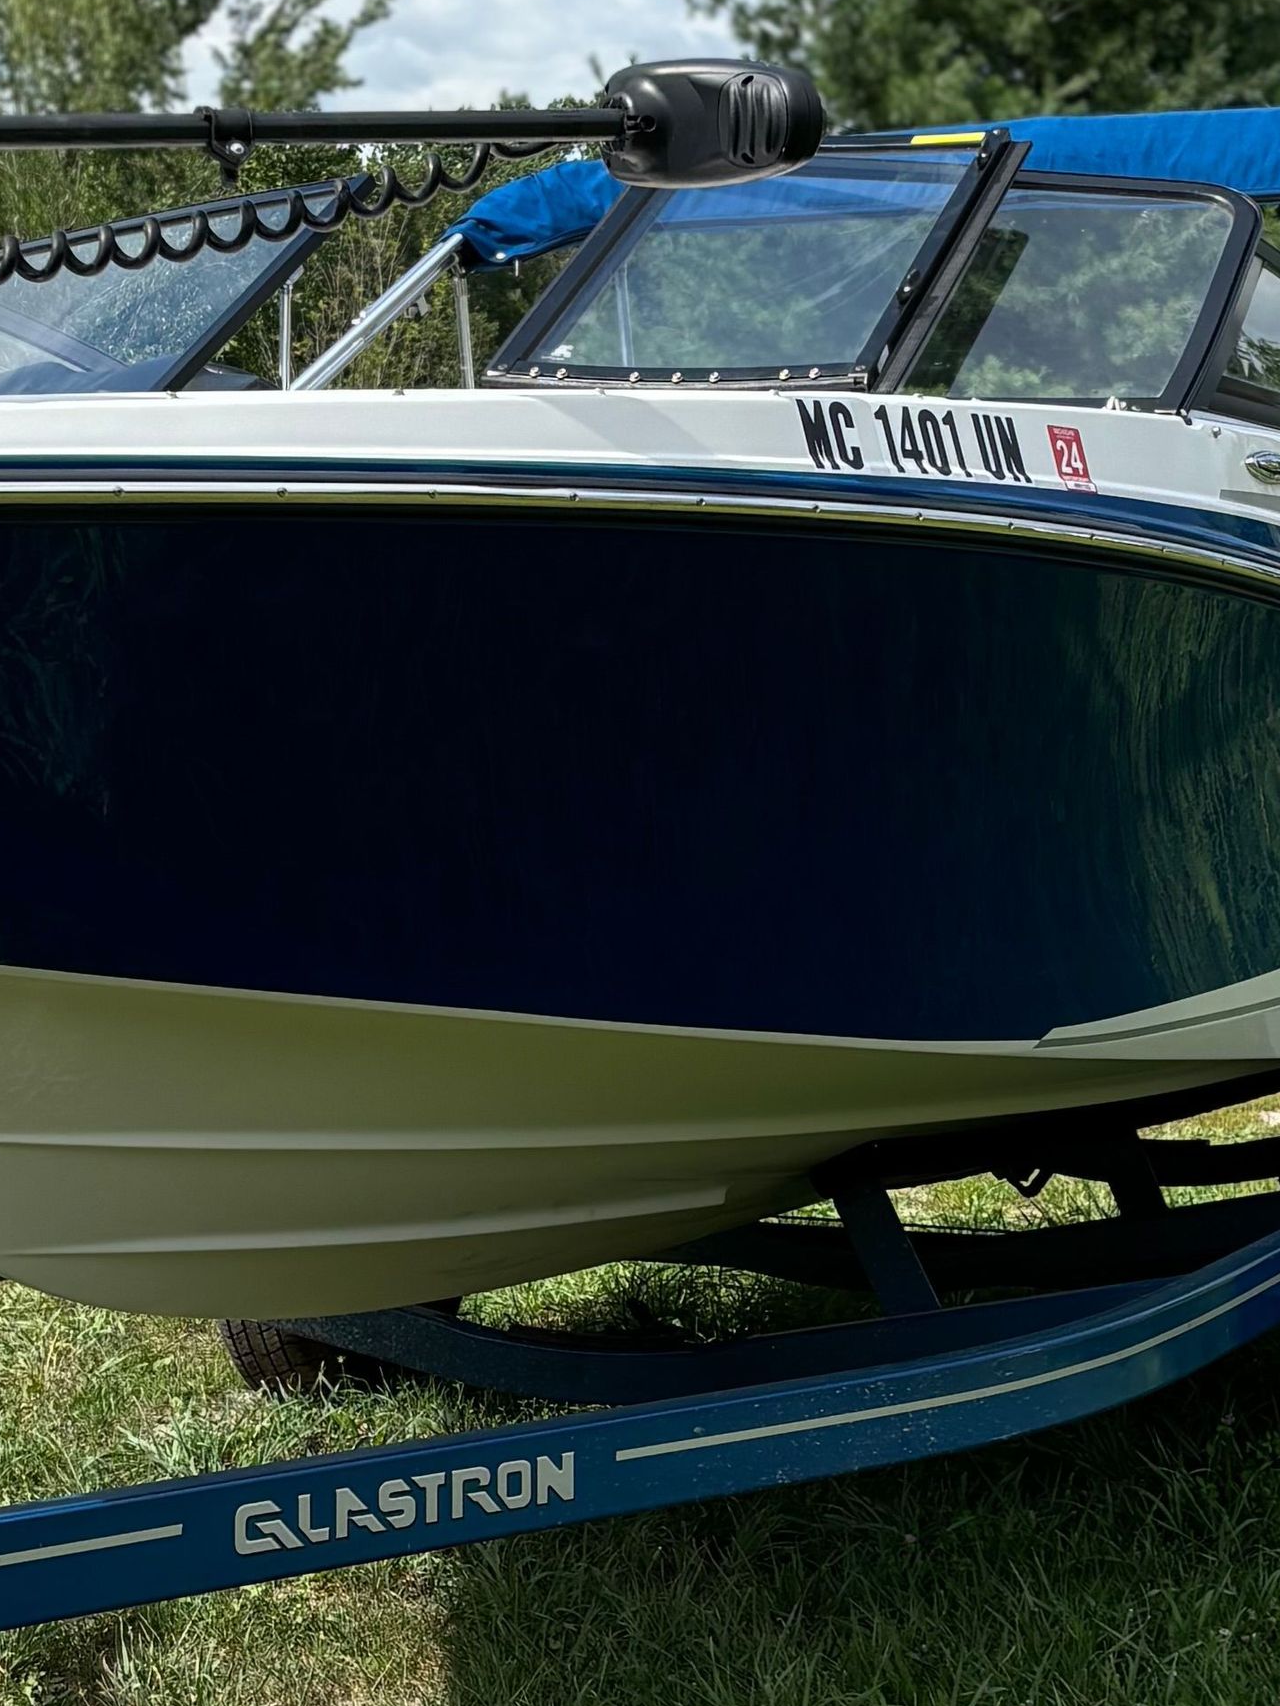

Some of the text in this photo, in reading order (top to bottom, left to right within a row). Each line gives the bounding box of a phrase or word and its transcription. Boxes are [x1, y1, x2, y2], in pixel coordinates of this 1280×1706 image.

[795, 398, 1033, 484] MC 1401 UN
[1056, 439, 1084, 476] 24
[234, 1451, 575, 1556] GLASTRON
